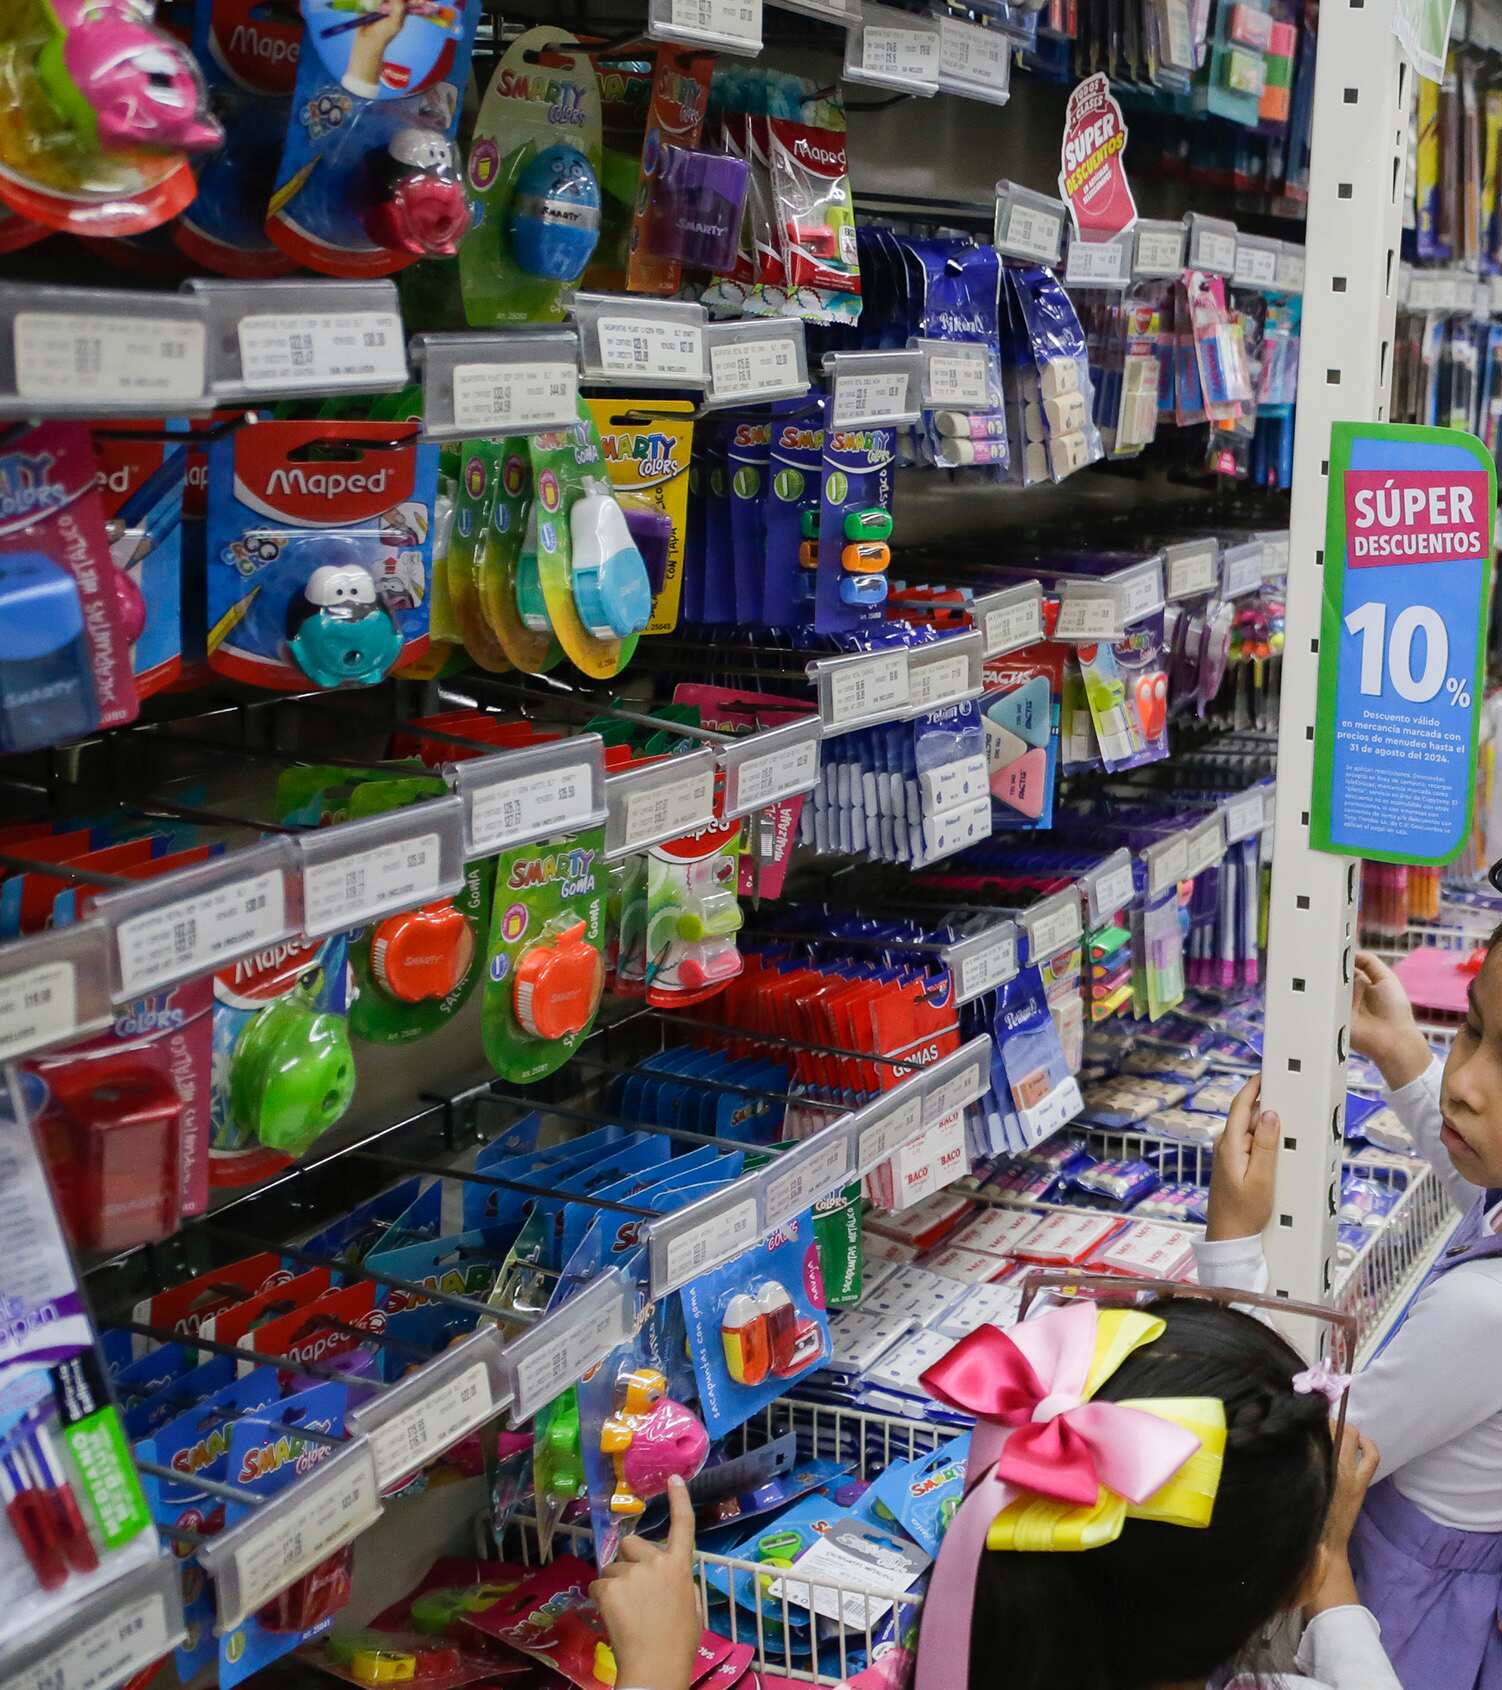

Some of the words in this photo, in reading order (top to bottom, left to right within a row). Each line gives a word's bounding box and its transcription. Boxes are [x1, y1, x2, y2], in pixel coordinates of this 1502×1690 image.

[230, 25, 300, 64] Mape
[497, 69, 586, 108] SMARTY
[794, 138, 847, 166] Maped
[675, 217, 729, 238] SMARTY
[600, 433, 677, 462] MARTY
[779, 426, 825, 450] SMA
[830, 431, 890, 453] SMARTY
[640, 458, 678, 477] COLORS
[266, 467, 387, 499] Maped
[1354, 479, 1475, 528] SÚPER
[57, 512, 98, 595] METÁLICO
[667, 527, 678, 557] TAPA
[1354, 531, 1480, 557] DESCUENTOS
[666, 560, 677, 580] CON
[86, 601, 117, 703] SACAPUNTAS
[1344, 601, 1471, 708] 10%
[983, 669, 1032, 685] FACTIS
[1342, 720, 1353, 728] en
[1403, 728, 1442, 739] marcada
[1444, 733, 1461, 741] con
[1363, 710, 1411, 723] Descuento
[1412, 716, 1441, 727] válido
[1337, 731, 1369, 742] precios
[1371, 734, 1383, 743] de
[1385, 736, 1427, 748] menudeo
[1429, 741, 1454, 752] hasta
[1456, 745, 1465, 753] el
[1349, 743, 1360, 752] 31
[1361, 744, 1373, 753] de
[1374, 746, 1406, 758] agosto
[1407, 750, 1422, 760] del
[1018, 769, 1028, 800] FACTIS
[774, 808, 792, 862] MANZANA
[507, 848, 596, 890] SMARTY
[234, 938, 314, 984] Mape
[404, 954, 443, 967] SMARTY
[114, 1007, 185, 1037] COLORS
[940, 1148, 962, 1166] BACO
[907, 1166, 929, 1185] BACO
[815, 1196, 848, 1211] COLORS
[847, 1207, 857, 1242] METÁLICO
[842, 1245, 857, 1294] SACAPUNTAS
[689, 1287, 701, 1320] goma
[695, 1323, 704, 1344] con
[701, 1348, 721, 1419] sacapuntas
